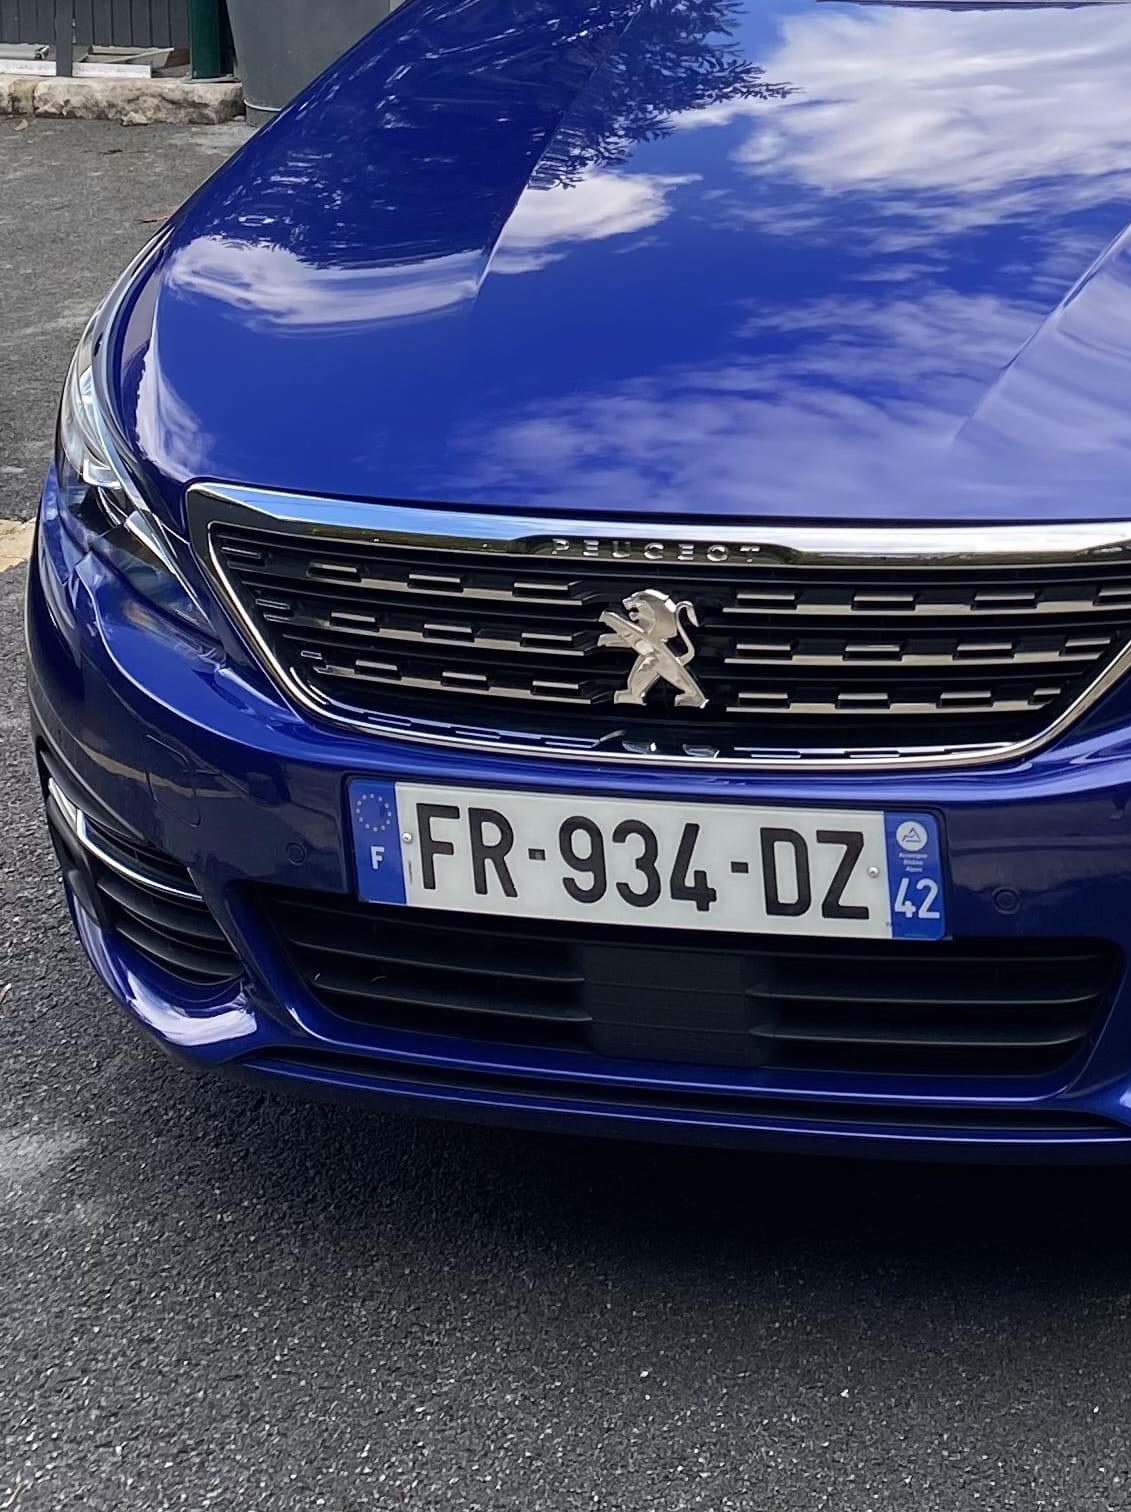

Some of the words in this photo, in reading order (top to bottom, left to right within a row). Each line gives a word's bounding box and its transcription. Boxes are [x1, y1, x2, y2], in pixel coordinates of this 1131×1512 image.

[552, 538, 761, 563] PEUGEOT
[370, 845, 385, 870] F
[415, 801, 871, 920] FR-934-DZ
[894, 877, 941, 920] 42
